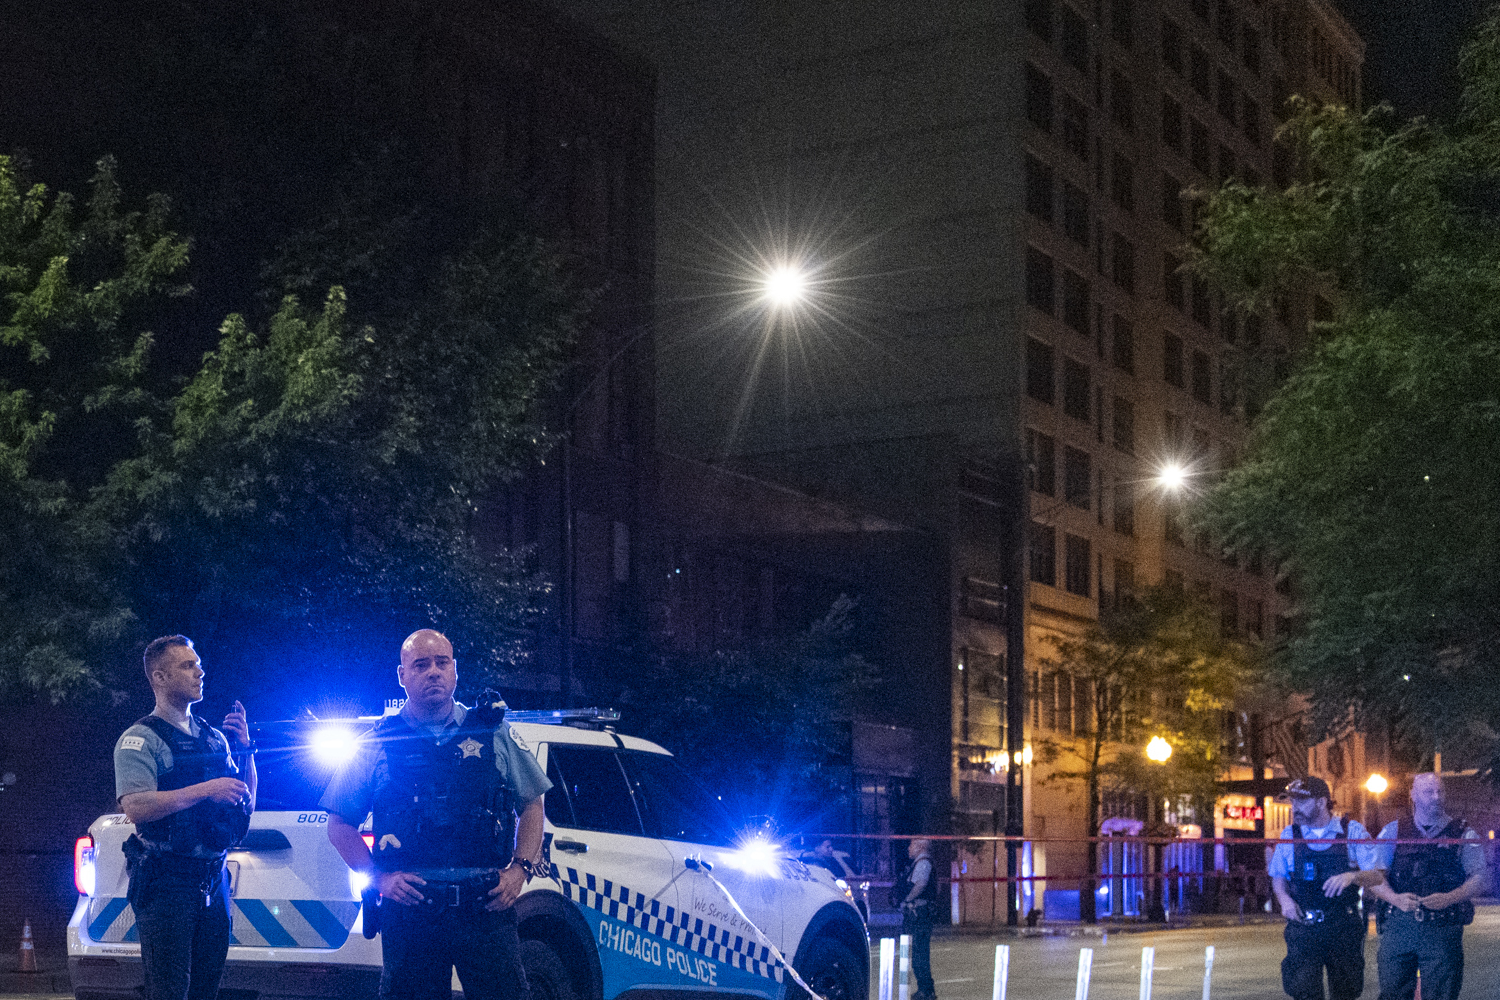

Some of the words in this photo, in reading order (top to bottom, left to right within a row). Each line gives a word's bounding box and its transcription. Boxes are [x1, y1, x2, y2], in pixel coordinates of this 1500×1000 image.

[297, 813, 329, 824] 806
[694, 898, 708, 914] We
[707, 902, 729, 923] Serve
[729, 913, 737, 927] &
[598, 919, 662, 967] CHICAGO
[666, 946, 718, 987] POLICE
